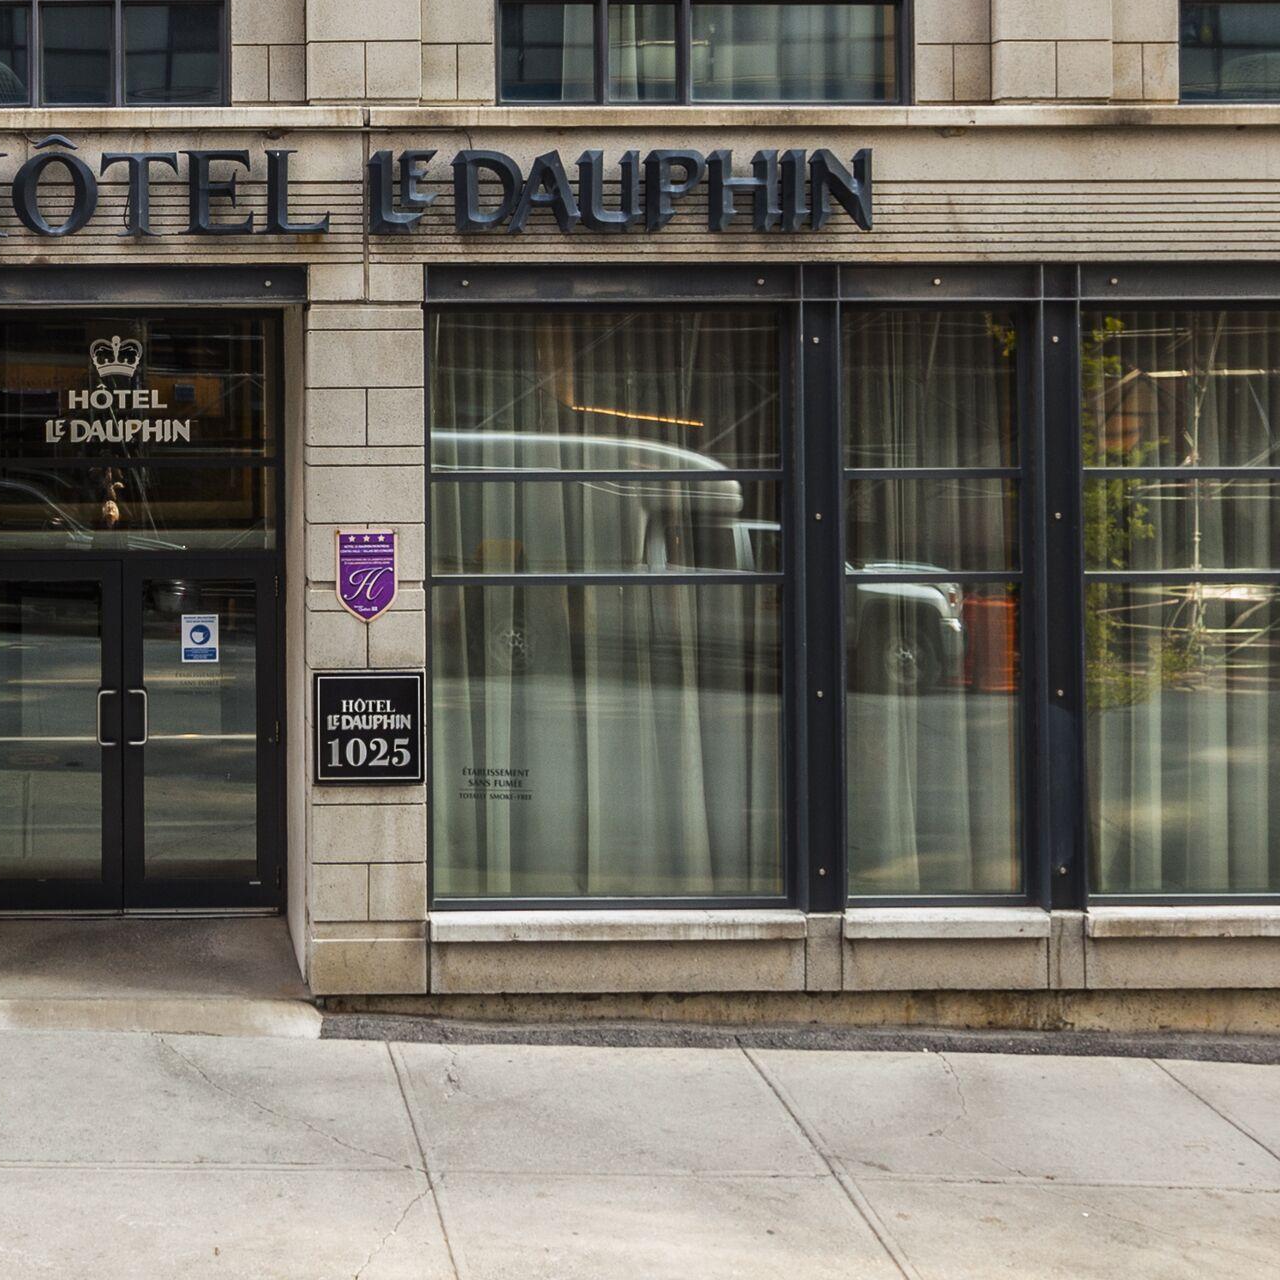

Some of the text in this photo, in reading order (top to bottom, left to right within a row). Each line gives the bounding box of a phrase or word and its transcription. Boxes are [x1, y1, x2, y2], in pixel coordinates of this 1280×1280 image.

[367, 149, 439, 235] LE
[451, 148, 873, 234] DAUPHIN
[69, 383, 168, 409] HÔTEL
[45, 420, 191, 443] LE DAUPHIN
[341, 698, 396, 713] HÔTEL
[341, 714, 412, 730] DAUPHIN
[327, 737, 412, 767] 1025
